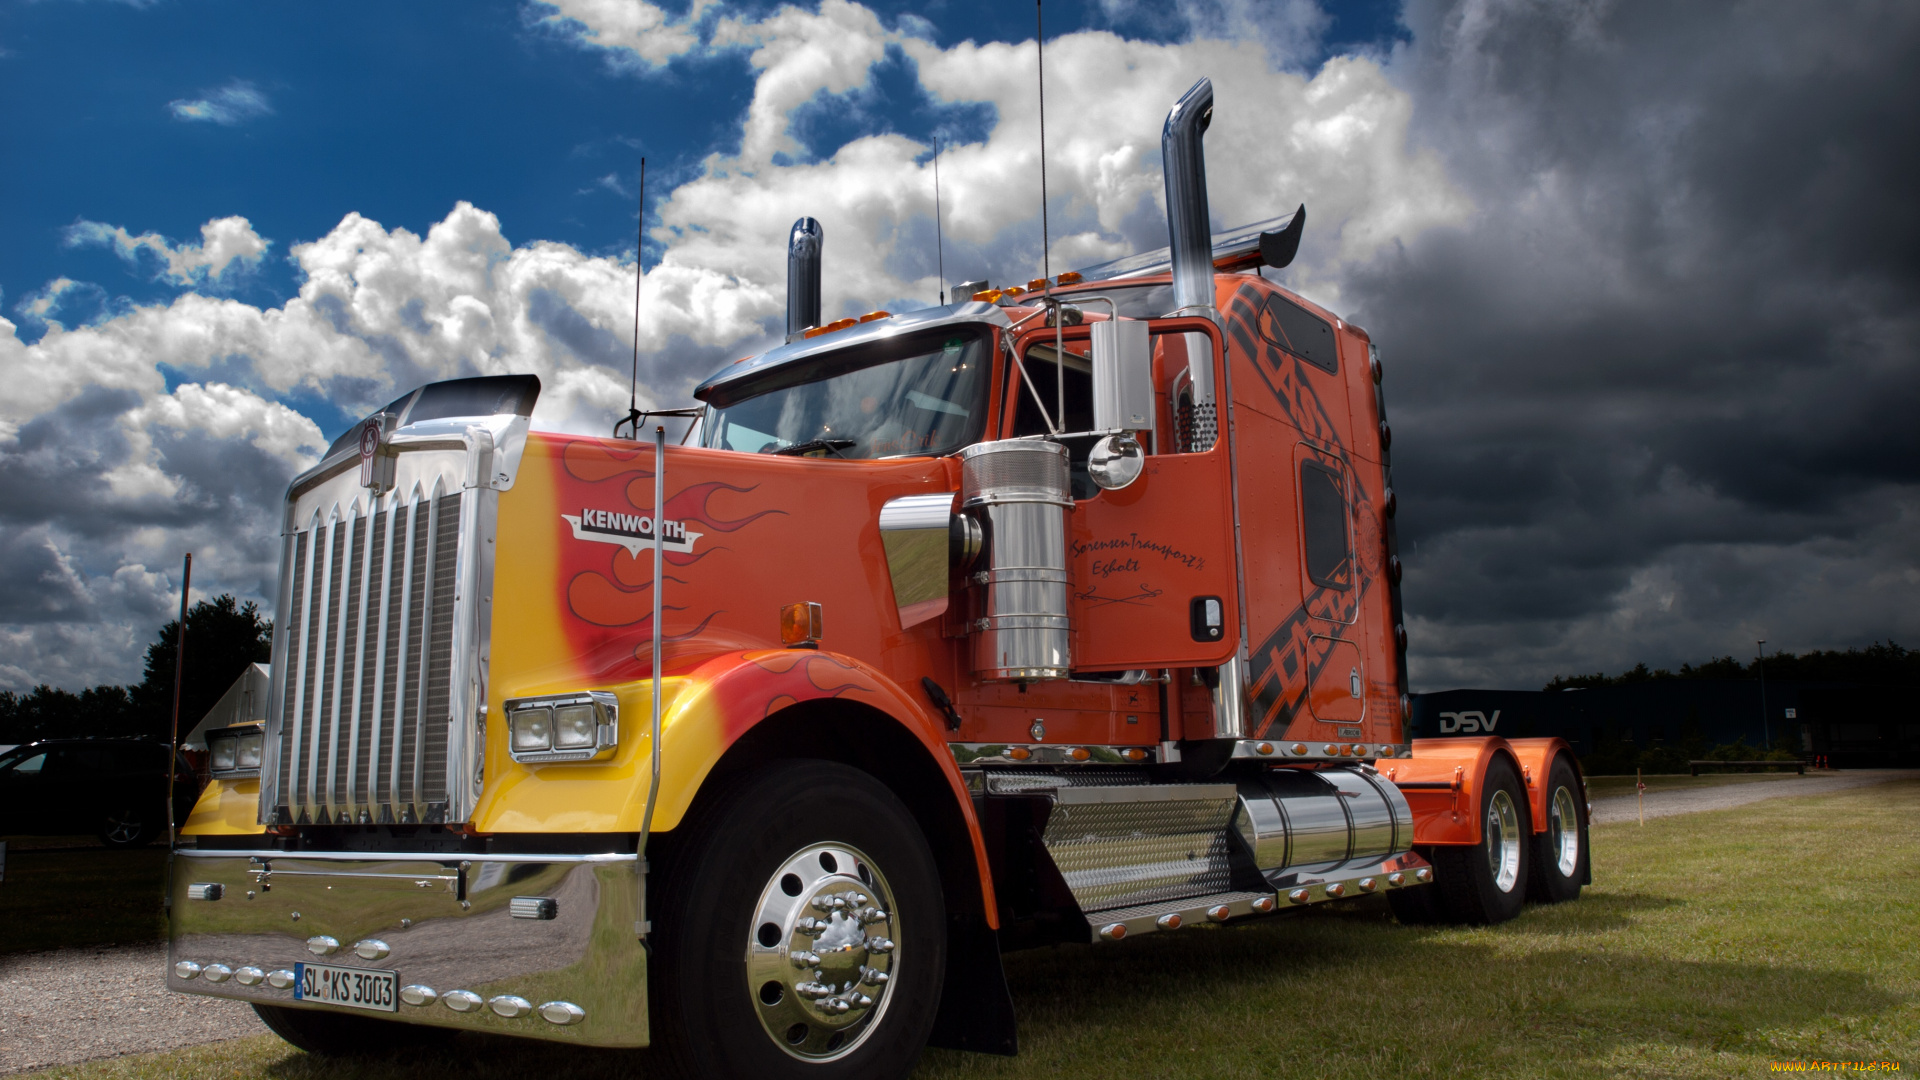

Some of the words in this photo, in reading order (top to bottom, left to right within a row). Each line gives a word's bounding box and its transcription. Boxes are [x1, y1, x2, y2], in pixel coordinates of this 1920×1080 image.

[582, 508, 686, 539] KENWOTH
[1092, 558, 1141, 578] Egholt
[1439, 709, 1501, 733] DSV
[303, 967, 321, 998] SL
[331, 970, 351, 1002] KS
[353, 973, 393, 1007] 3003
